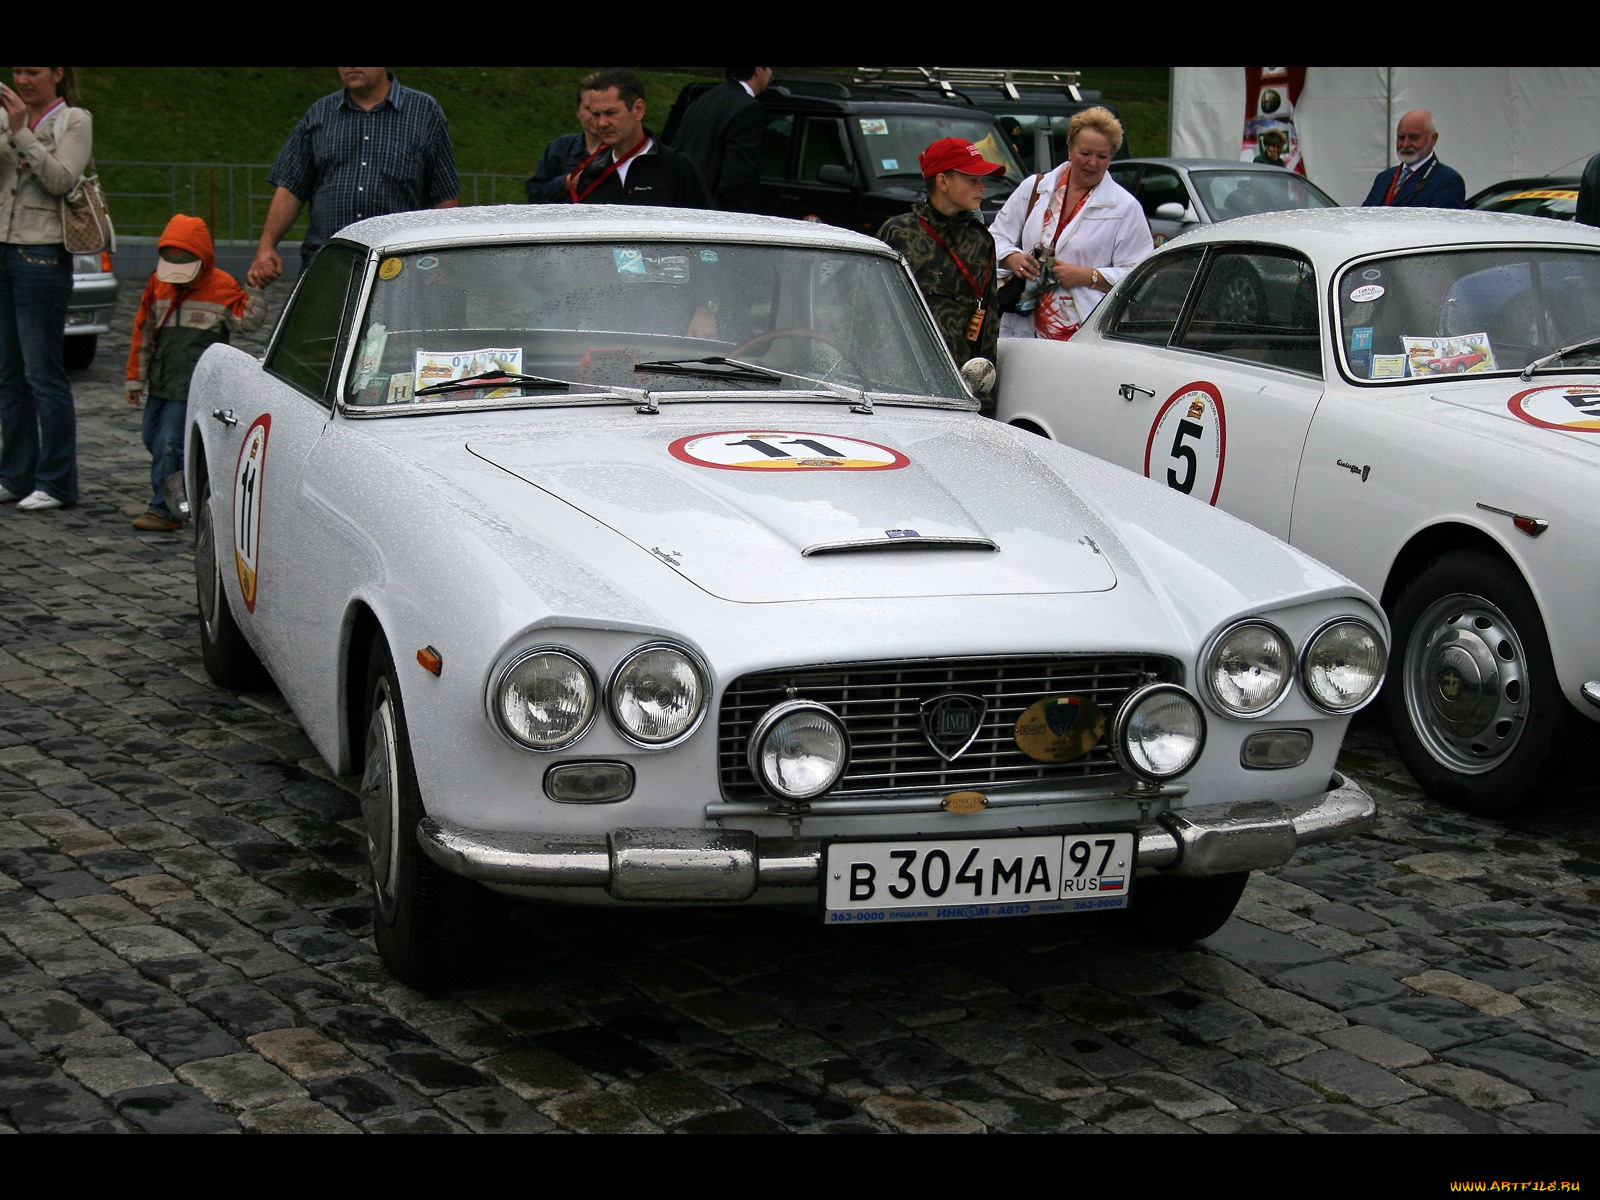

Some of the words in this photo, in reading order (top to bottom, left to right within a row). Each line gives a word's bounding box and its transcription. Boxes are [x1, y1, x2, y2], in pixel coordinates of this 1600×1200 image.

[725, 438, 847, 458] 11
[1167, 419, 1204, 495] 5
[241, 460, 257, 559] 11
[1069, 839, 1116, 877] 97
[1063, 878, 1098, 892] RUS
[831, 911, 885, 922] 363-0000
[1073, 898, 1123, 909] 363-0000
